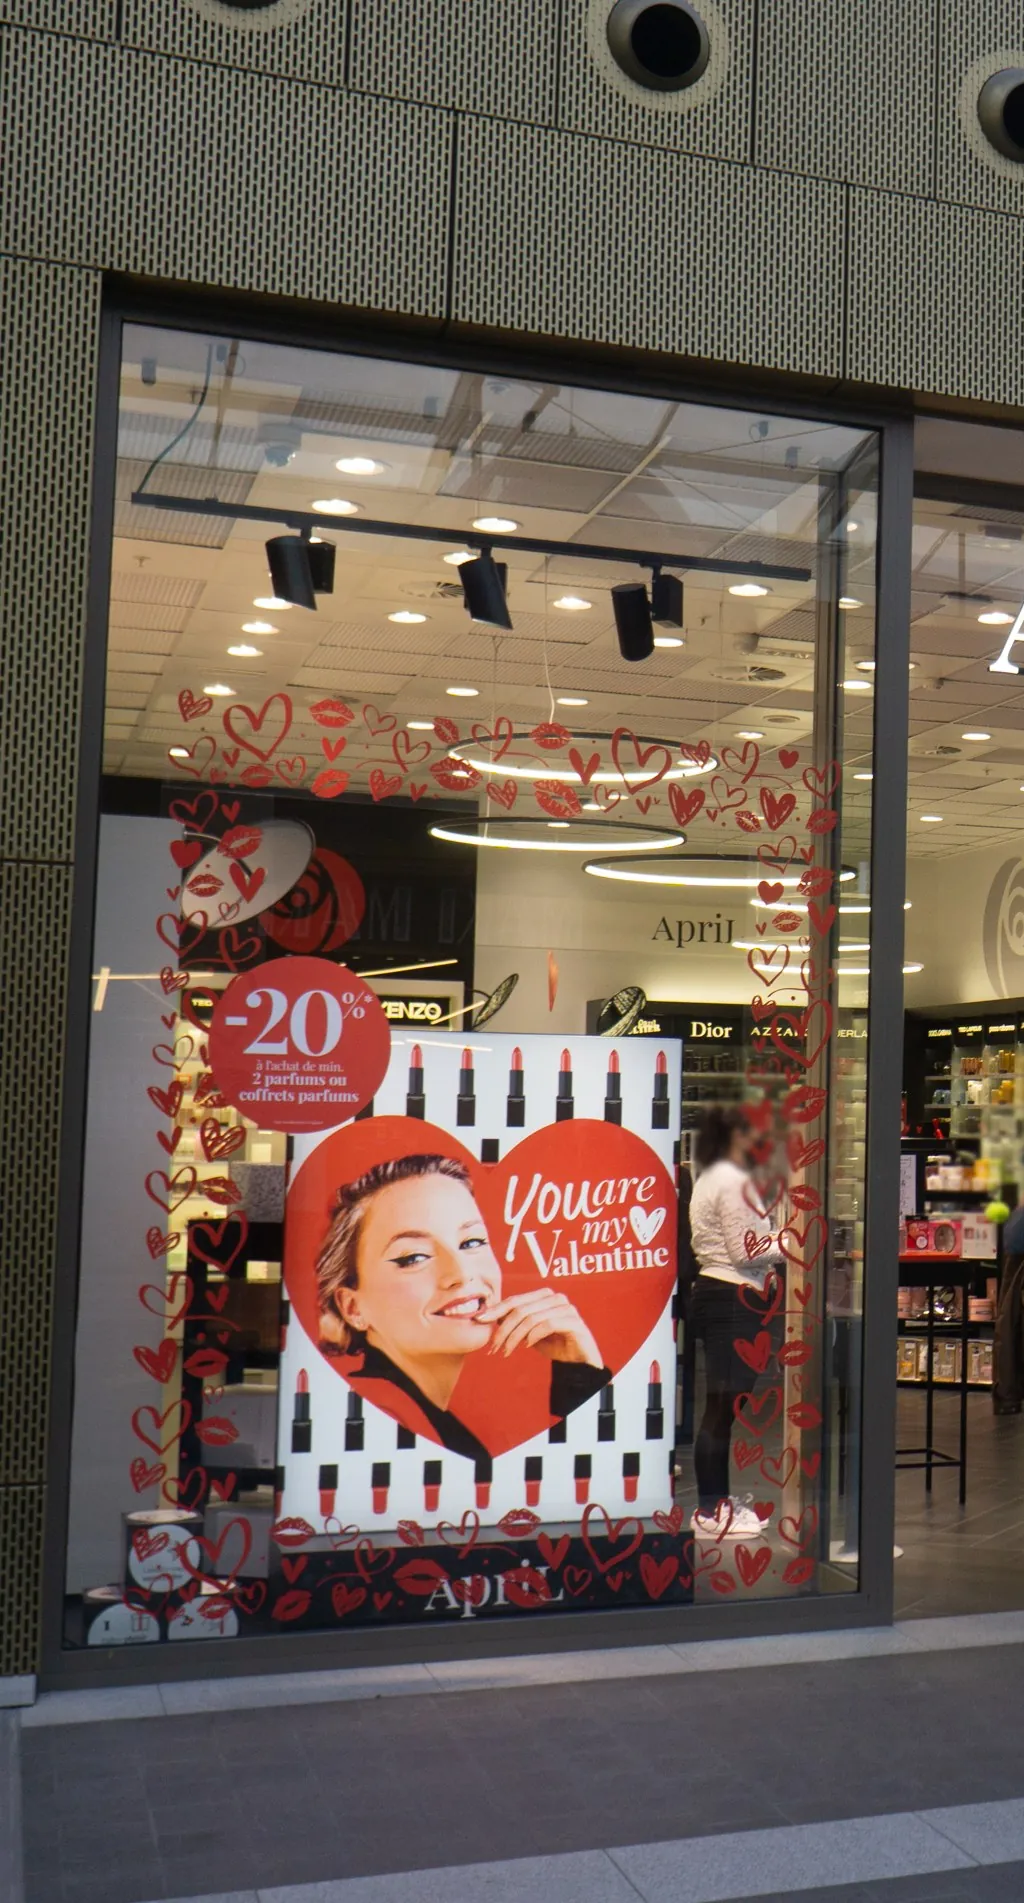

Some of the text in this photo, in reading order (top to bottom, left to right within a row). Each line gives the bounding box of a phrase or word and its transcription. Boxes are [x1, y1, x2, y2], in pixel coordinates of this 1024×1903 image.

[690, 1021, 733, 1038] Dior
[750, 1026, 809, 1037] AZZA
[837, 1028, 868, 1038] ERLA
[302, 1060, 317, 1072] de
[319, 1060, 344, 1072] min.
[252, 1072, 347, 1088] 2 parfums ou
[238, 1089, 360, 1105] coffrets parfums
[592, 1175, 656, 1207] are
[582, 1216, 628, 1247] my
[522, 1229, 669, 1279] Valentine
